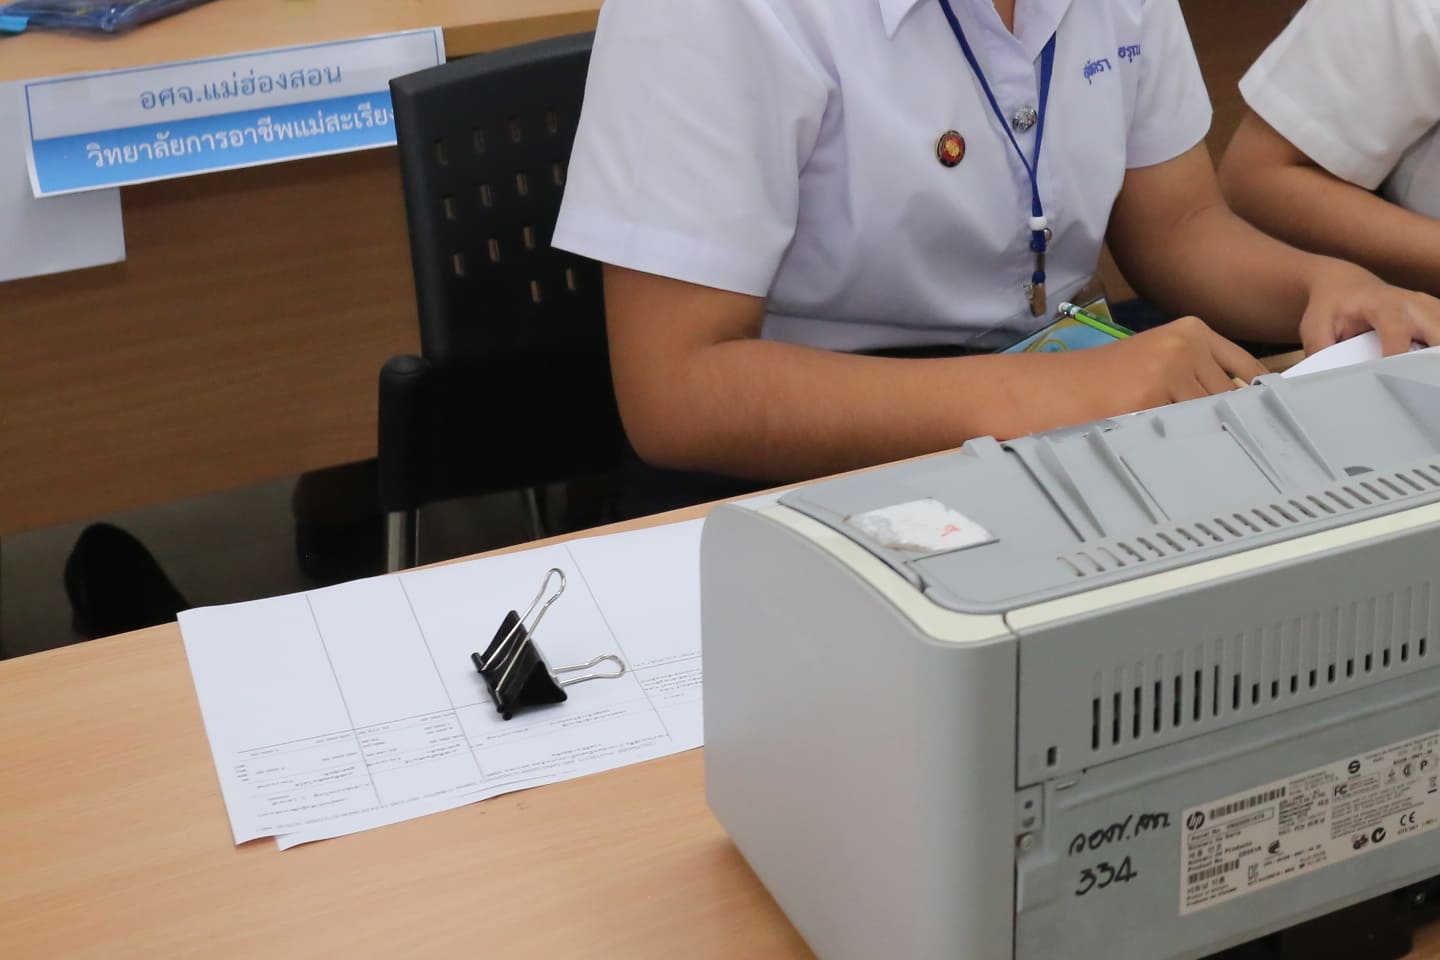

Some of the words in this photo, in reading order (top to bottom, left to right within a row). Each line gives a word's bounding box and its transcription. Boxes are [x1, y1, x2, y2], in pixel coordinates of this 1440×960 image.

[139, 63, 343, 111] อศจ.แม่ฮ่องสอน
[1075, 856, 1138, 896] 334
